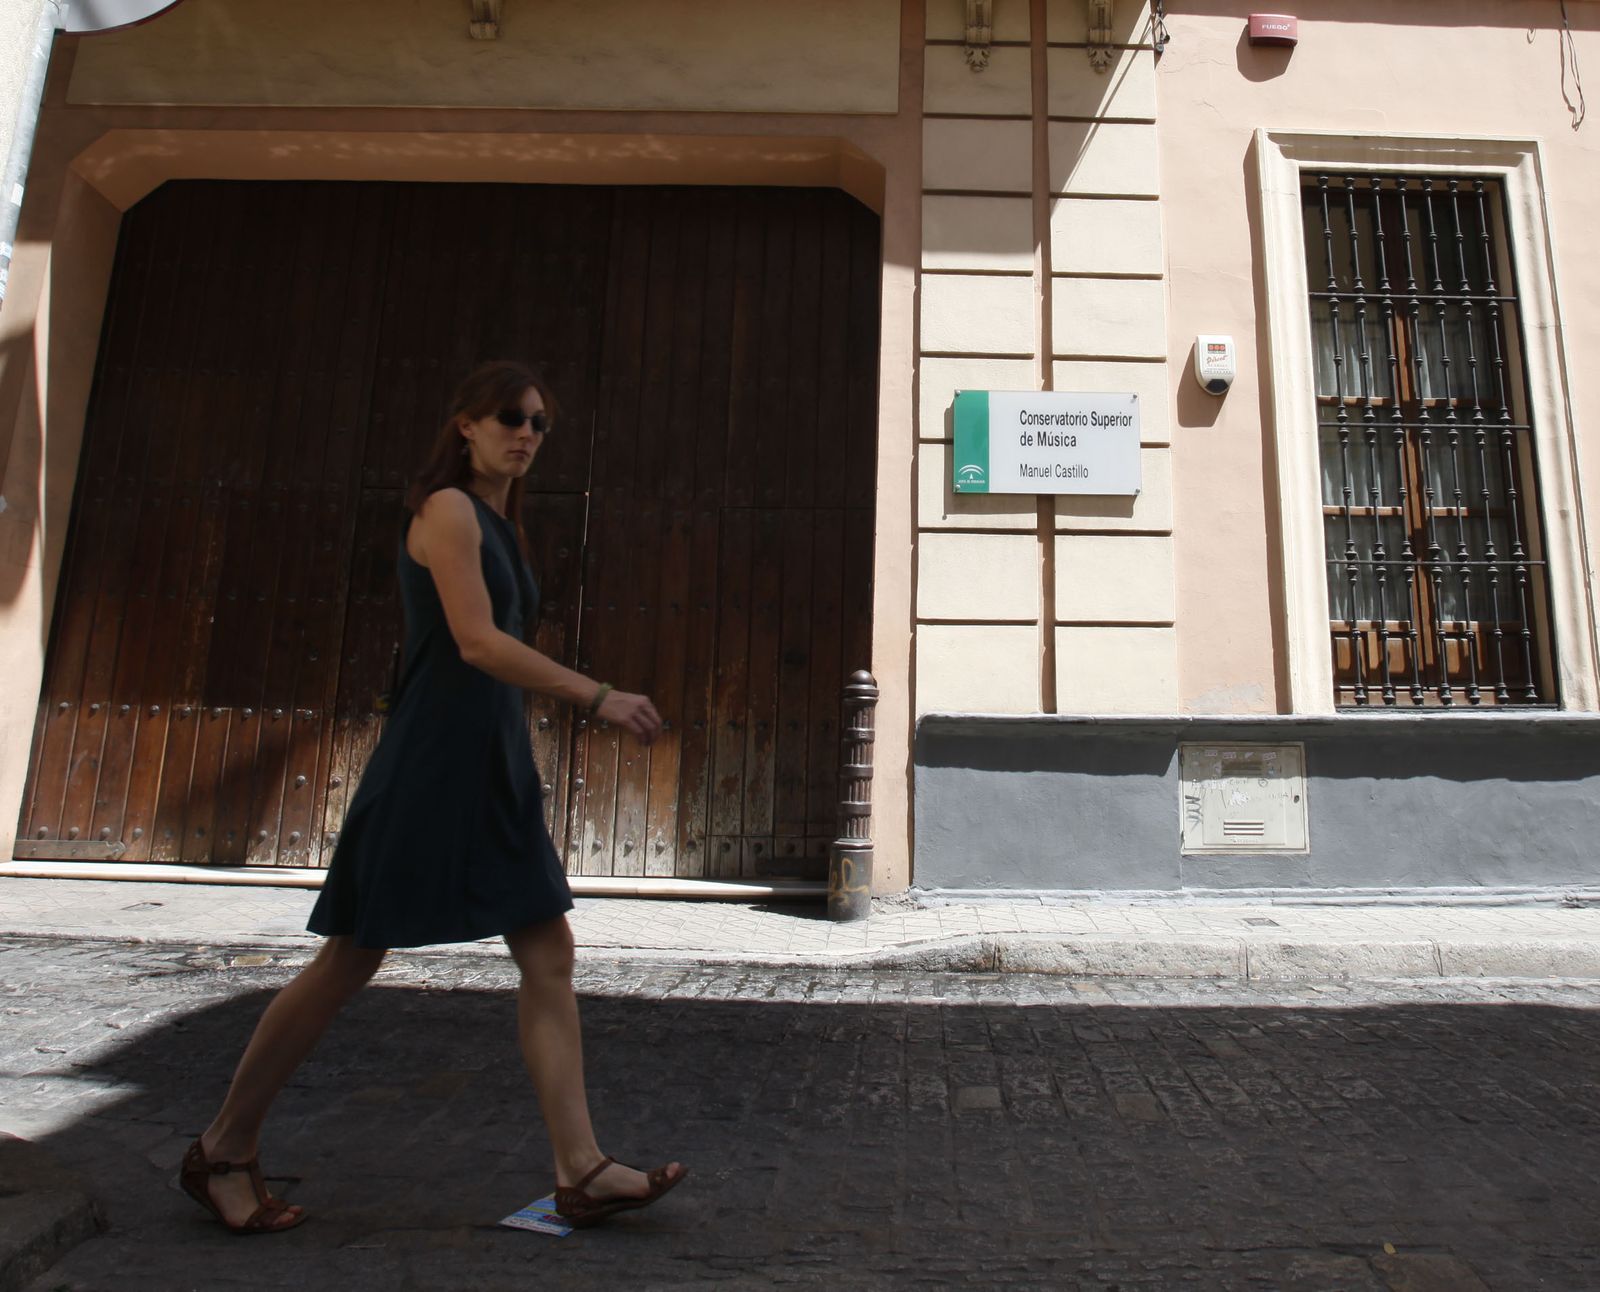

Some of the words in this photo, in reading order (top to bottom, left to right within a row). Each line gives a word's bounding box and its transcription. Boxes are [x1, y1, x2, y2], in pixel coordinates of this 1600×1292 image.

[1019, 410, 1088, 426] Conservatorio
[1090, 411, 1132, 429] Superior
[1019, 432, 1034, 447] de
[1037, 431, 1077, 447] Música
[1019, 463, 1052, 478] Manuel
[1054, 463, 1089, 479] Castillo
